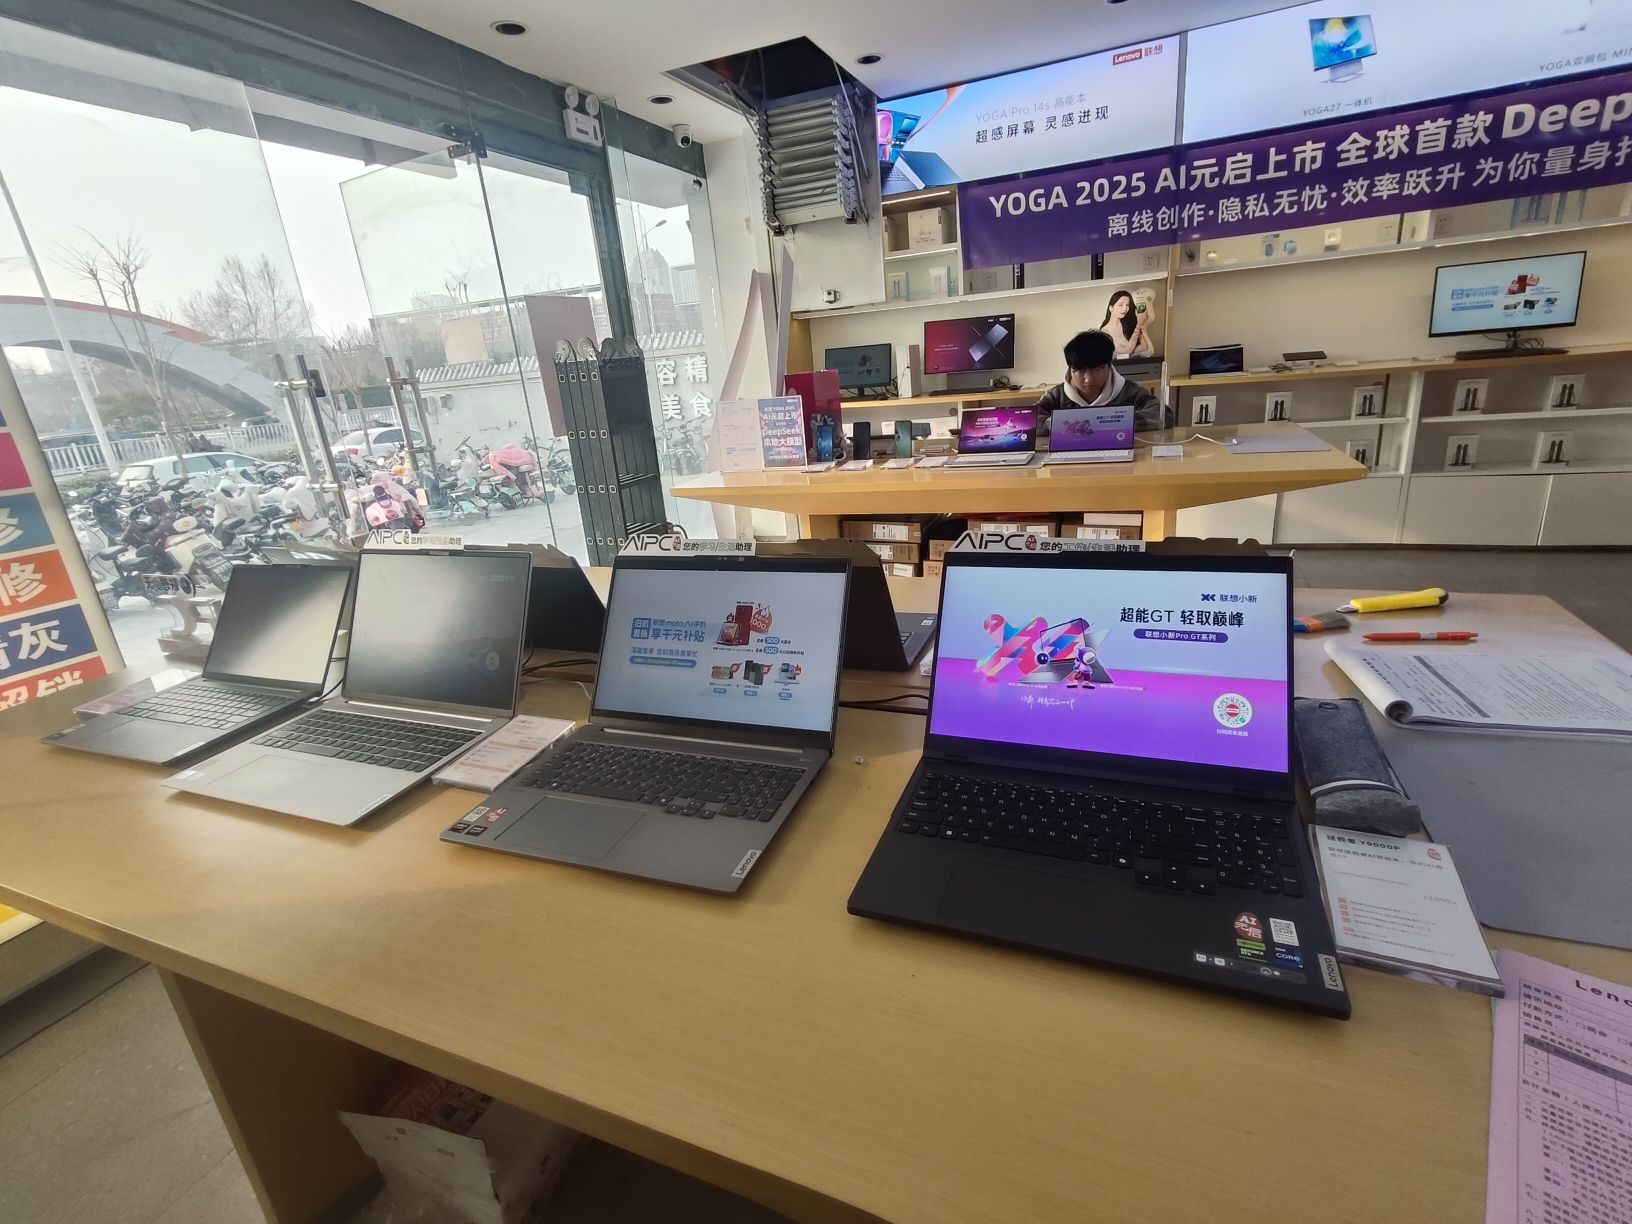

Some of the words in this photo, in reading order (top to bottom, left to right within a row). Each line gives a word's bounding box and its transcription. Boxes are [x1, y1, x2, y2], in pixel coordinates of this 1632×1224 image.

[1114, 51, 1141, 64] Lenovo
[1144, 44, 1162, 57] 联想
[975, 110, 1008, 125] YOGA
[1011, 106, 1030, 118] Pro
[1034, 102, 1050, 113] 14s
[1303, 102, 1341, 117] YOGA27
[1344, 97, 1373, 109] 一体机
[975, 119, 1035, 144] 超感屏幕
[988, 185, 1069, 218] YOGA
[1075, 172, 1146, 206] 2025
[1154, 141, 1327, 195] AI元启上市
[1336, 110, 1494, 168] 全球首款
[1501, 91, 1632, 139] Deep
[1107, 162, 1466, 239] 离线创作·隐私无忧·效率跃升
[660, 391, 713, 421] 美食
[762, 426, 801, 437] DeepSeek
[763, 437, 803, 447] 本地大模型
[367, 529, 403, 545] AIPC
[622, 535, 673, 551] AIPC
[954, 532, 1025, 551] AIPC
[1219, 593, 1258, 604] 联想小新
[1120, 606, 1175, 624] 超能GT
[1180, 609, 1245, 628] 轻取巅峰
[651, 628, 706, 643] 享千元补贴
[1144, 630, 1189, 640] 联想小新Pro
[1190, 632, 1217, 642] GT系列
[1359, 840, 1401, 851] Y9000P
[735, 851, 757, 875] Lenovo
[1239, 915, 1257, 926] AI
[1324, 957, 1339, 987] Lenovo
